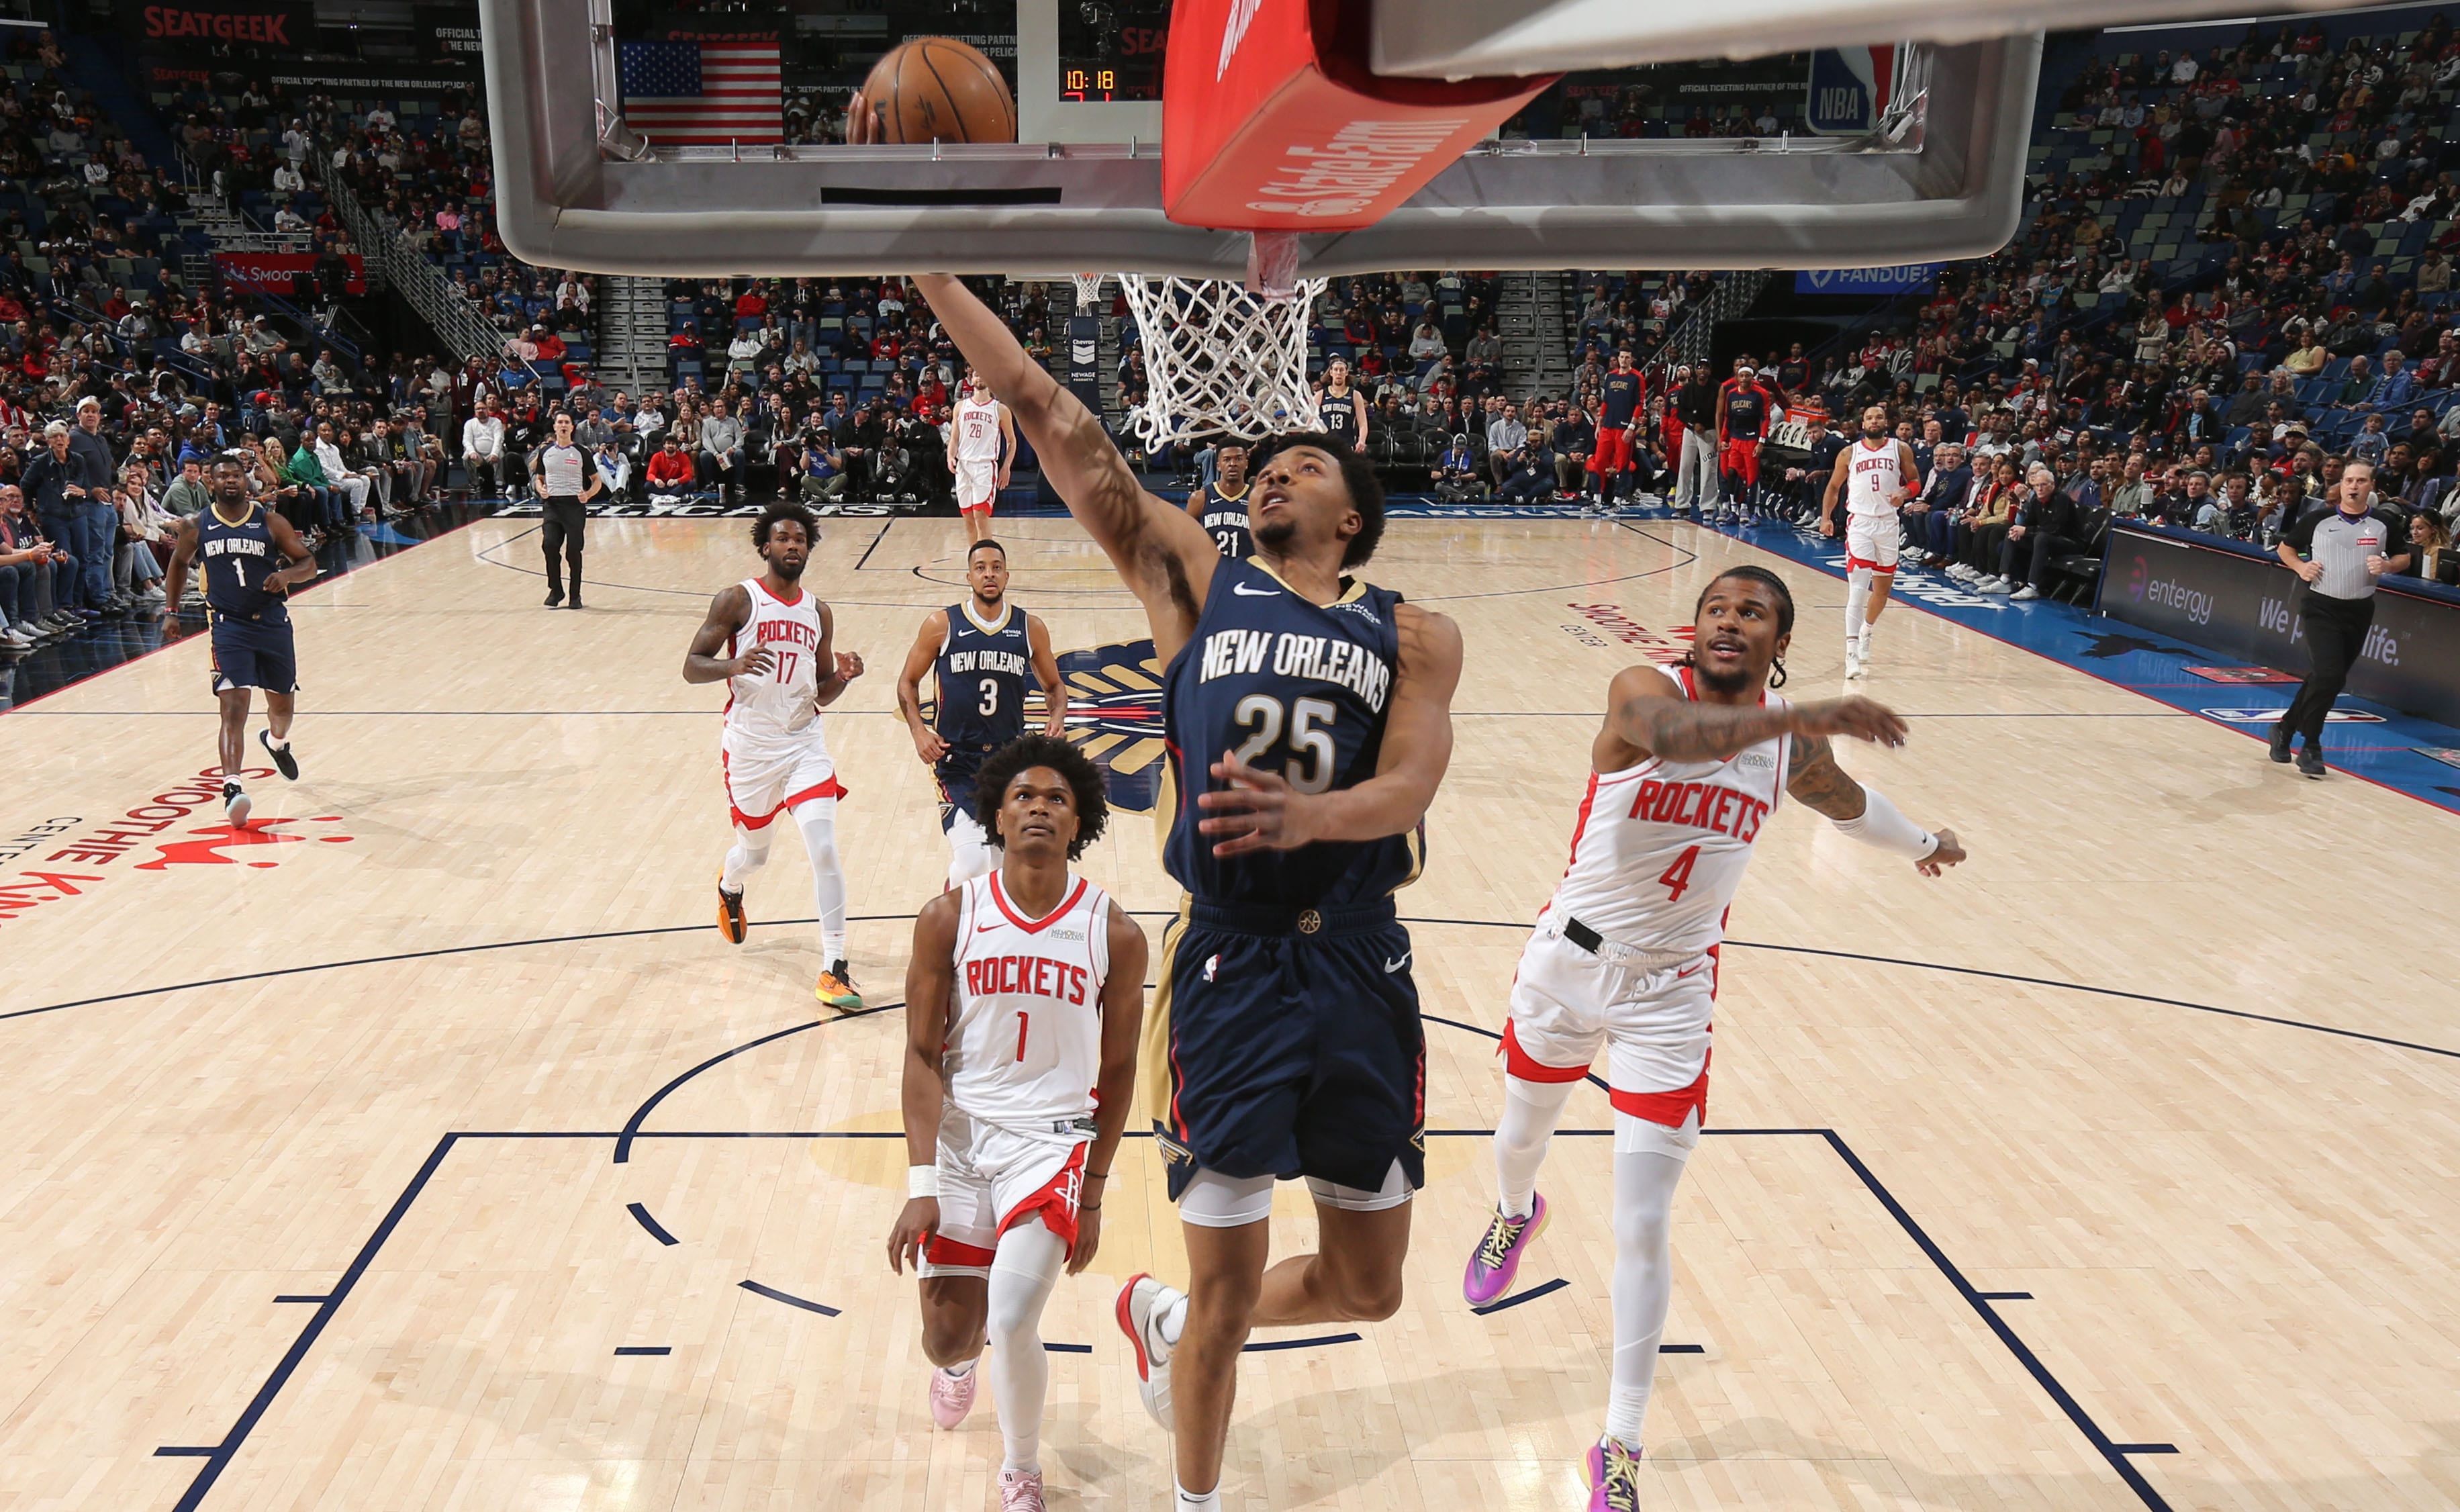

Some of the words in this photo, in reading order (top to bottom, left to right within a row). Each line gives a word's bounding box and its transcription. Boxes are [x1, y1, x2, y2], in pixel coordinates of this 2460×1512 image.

[144, 5, 290, 46] SEATGEEK
[436, 28, 474, 38] OFFICIAL
[339, 78, 371, 87] PARTNER
[1066, 70, 1115, 90] 10:18
[1818, 87, 1859, 120] NBA
[1838, 267, 1932, 284] FANDUEL
[964, 411, 993, 424] ROCKETS
[969, 423, 983, 438] 28
[1330, 414, 1343, 430] 13
[1856, 458, 1894, 475] ROCKETS
[1871, 474, 1880, 492] 9
[1204, 512, 1222, 529] NEW
[204, 538, 225, 558] NEW
[227, 538, 266, 557] ORLEANS
[1216, 530, 1239, 557] 21
[232, 557, 246, 587] 1
[2148, 579, 2214, 626] entergy
[757, 620, 816, 652] ROCKETS
[1566, 603, 1670, 646] SMOOTHIE
[2259, 598, 2289, 634] We
[2361, 624, 2400, 667] life.
[776, 651, 798, 685] 17
[949, 651, 975, 676] NEW
[978, 650, 1027, 677] ORLEANS
[1199, 628, 1274, 684] NEW
[1272, 632, 1390, 714] ORLEANS
[978, 678, 998, 717] 3
[1229, 693, 1337, 795] 25
[1627, 779, 1769, 844] ROCKETS
[1658, 845, 1701, 902] 4
[966, 955, 1088, 1006] ROCKETS
[1016, 1010, 1029, 1063] 1
